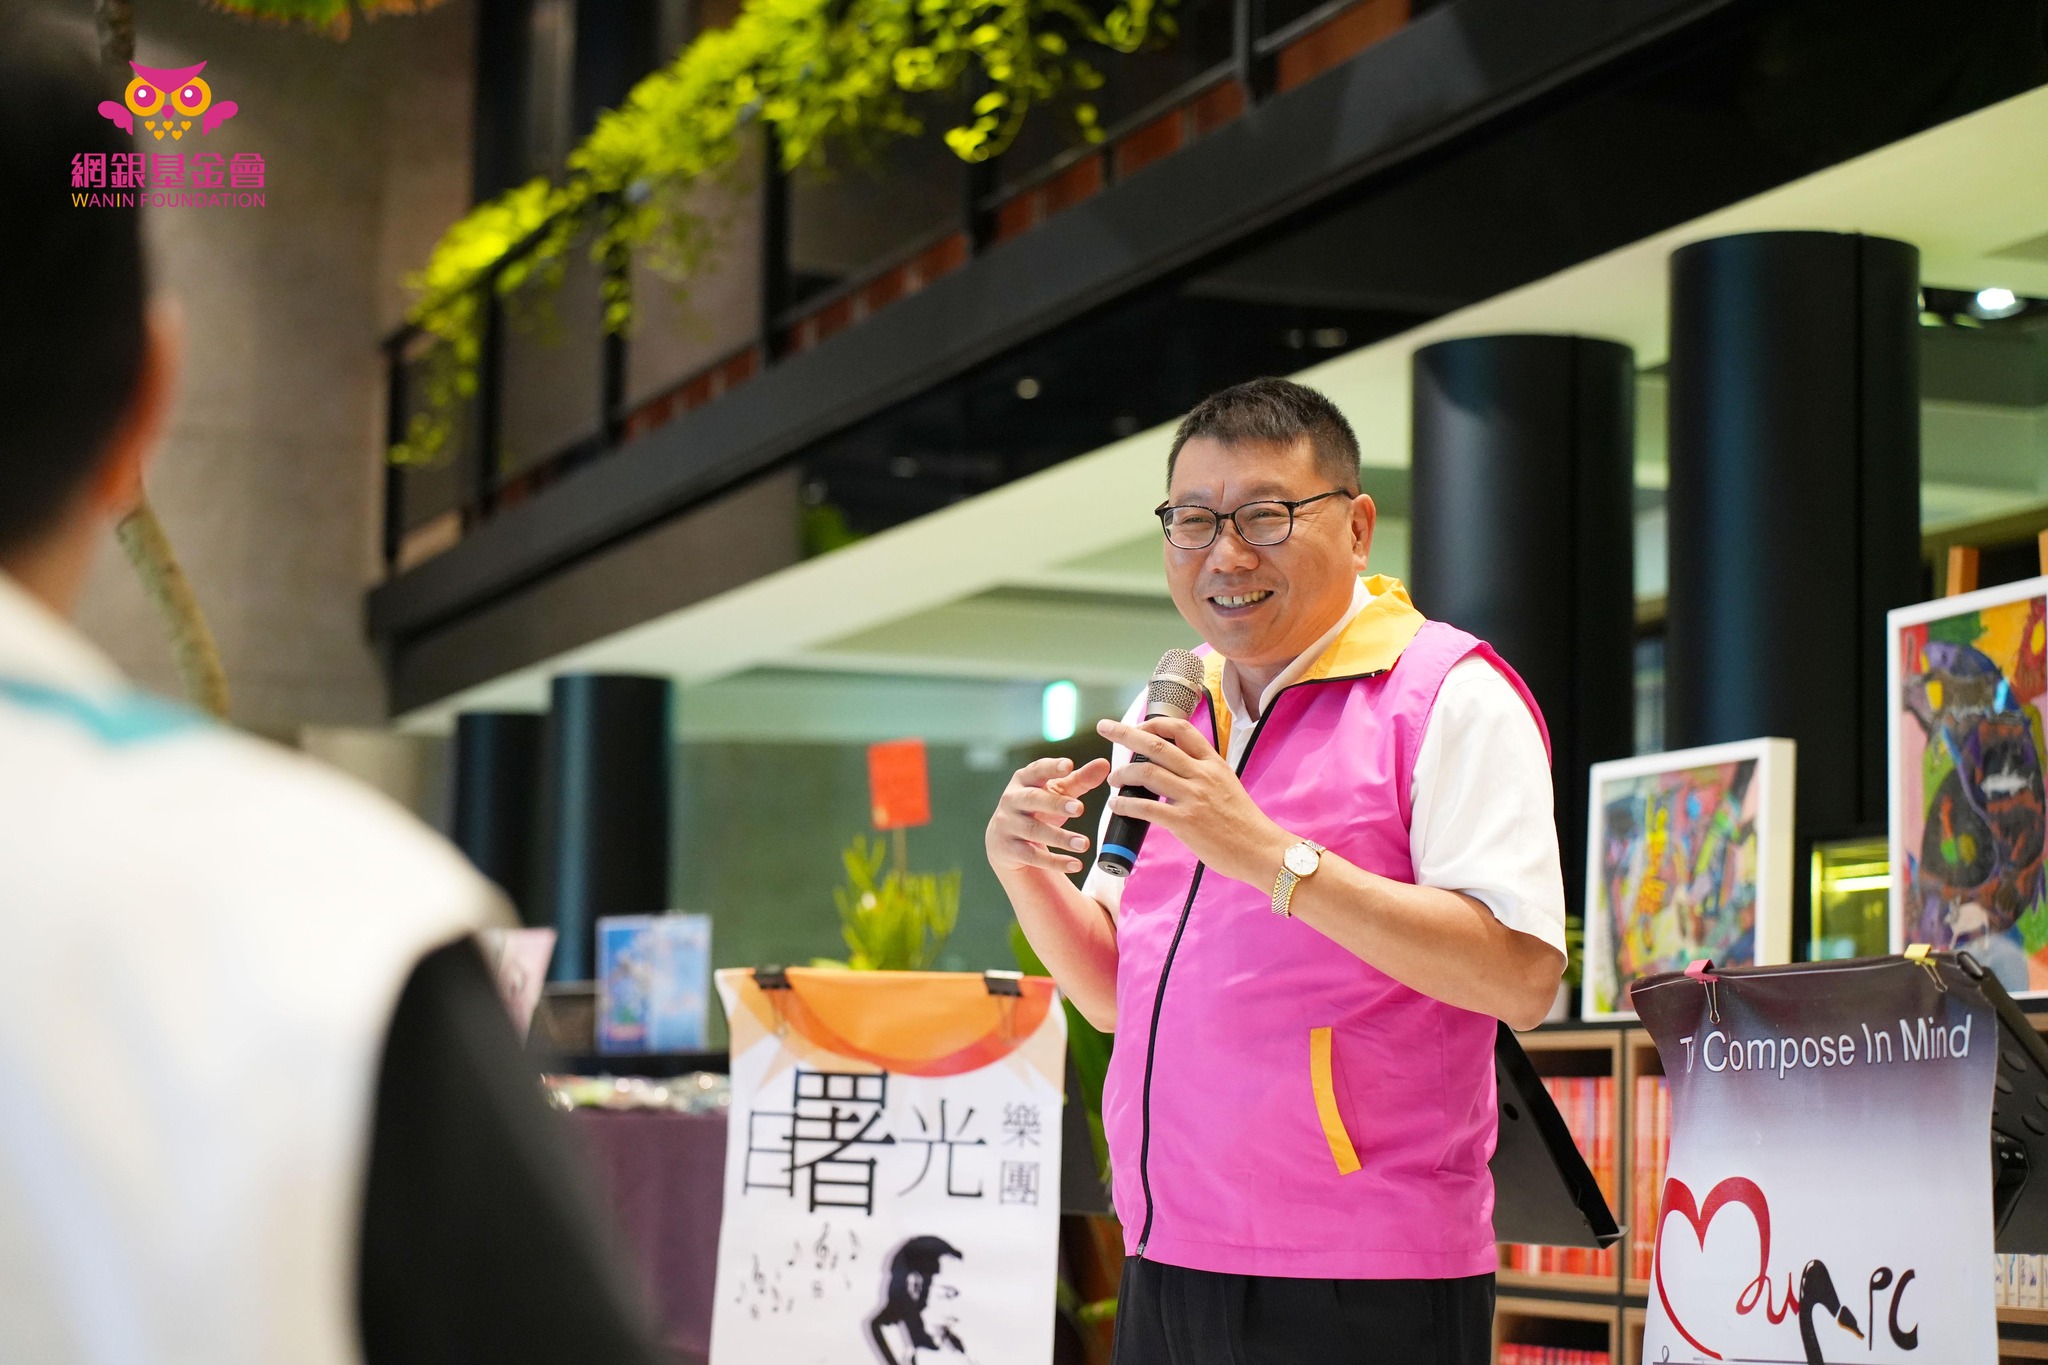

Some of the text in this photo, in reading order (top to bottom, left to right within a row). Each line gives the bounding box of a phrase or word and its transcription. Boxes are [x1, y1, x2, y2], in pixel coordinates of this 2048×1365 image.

[1702, 1030, 1856, 1080] Compose
[1861, 1022, 1893, 1064] In
[1898, 1013, 1972, 1062] Mind
[742, 1067, 988, 1217] 曙光
